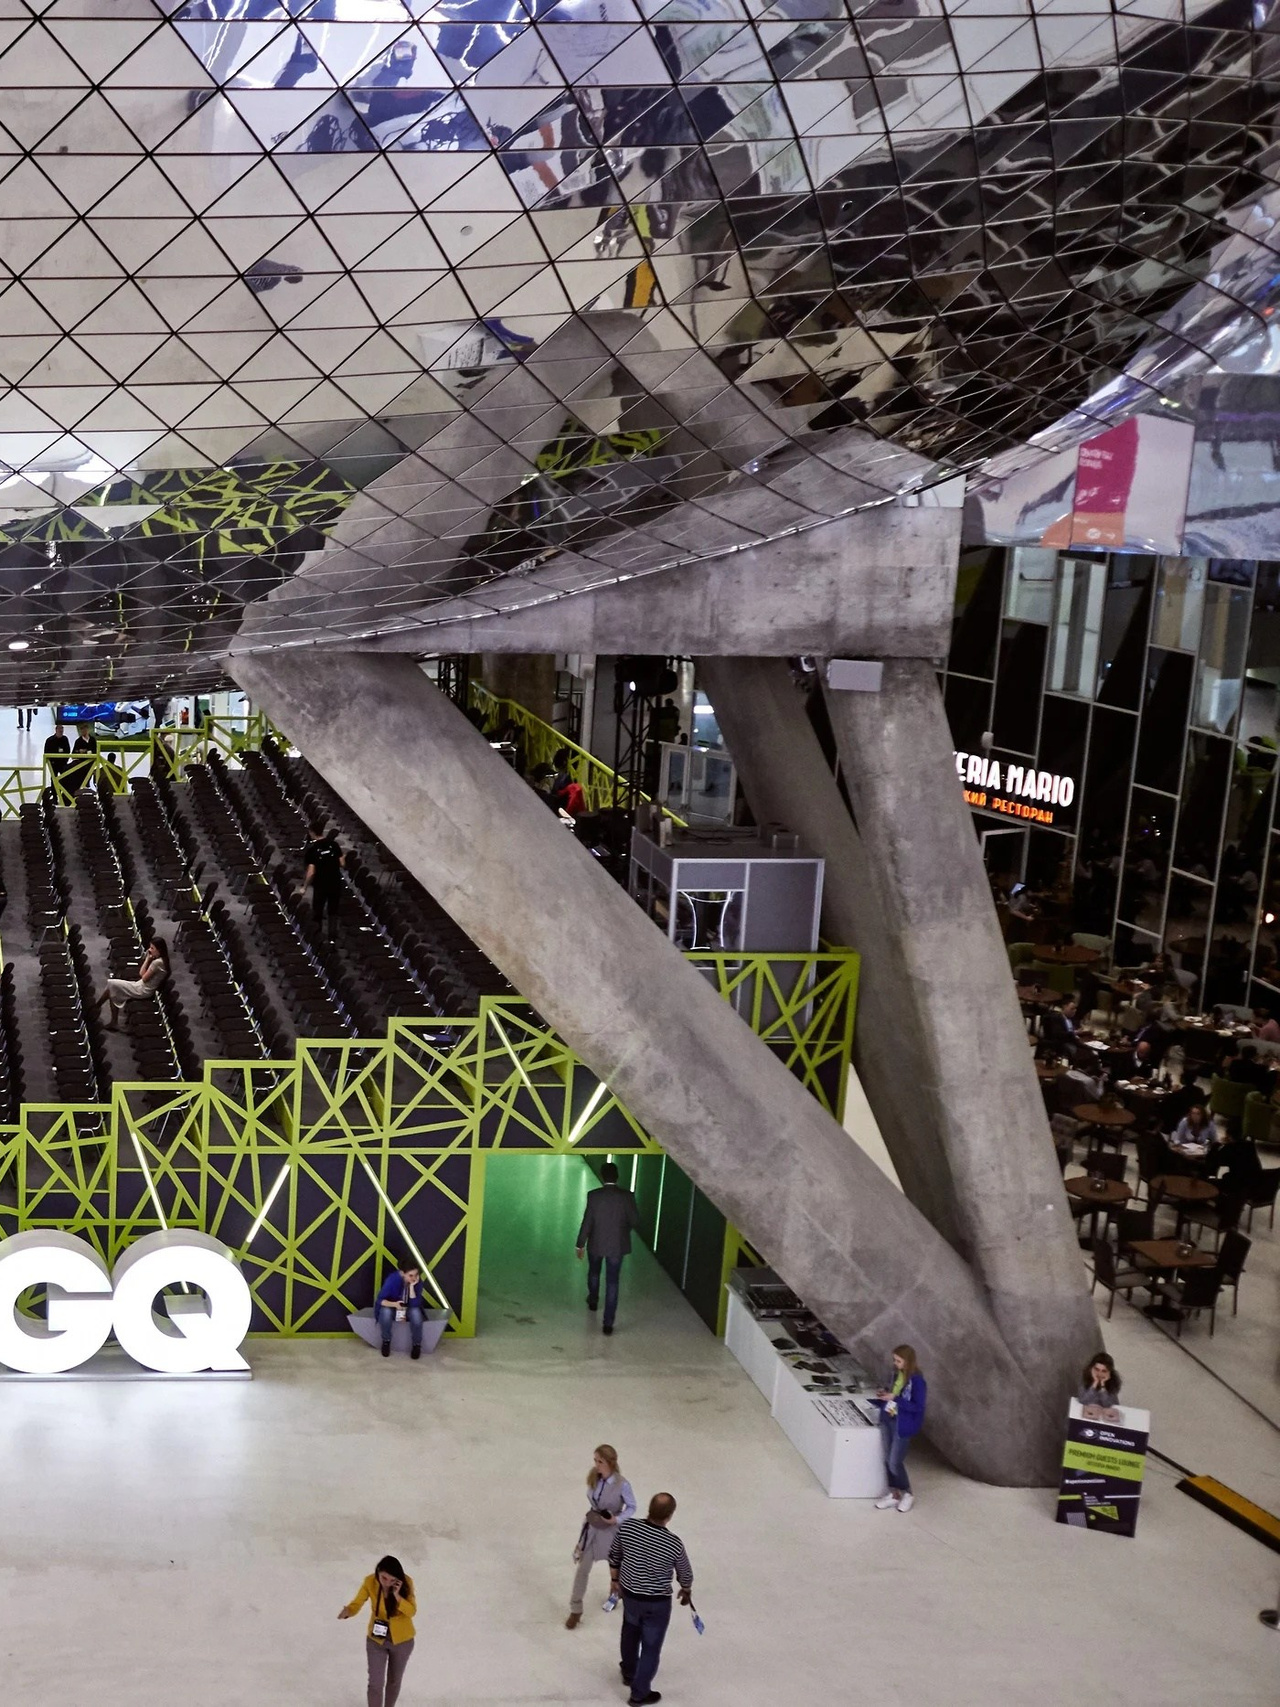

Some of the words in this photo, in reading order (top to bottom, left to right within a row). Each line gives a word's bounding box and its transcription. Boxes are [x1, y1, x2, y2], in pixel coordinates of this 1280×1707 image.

[953, 751, 1000, 790] ERIA
[1006, 764, 1074, 807] MARIO
[991, 797, 1053, 823] РЕСТОРАН
